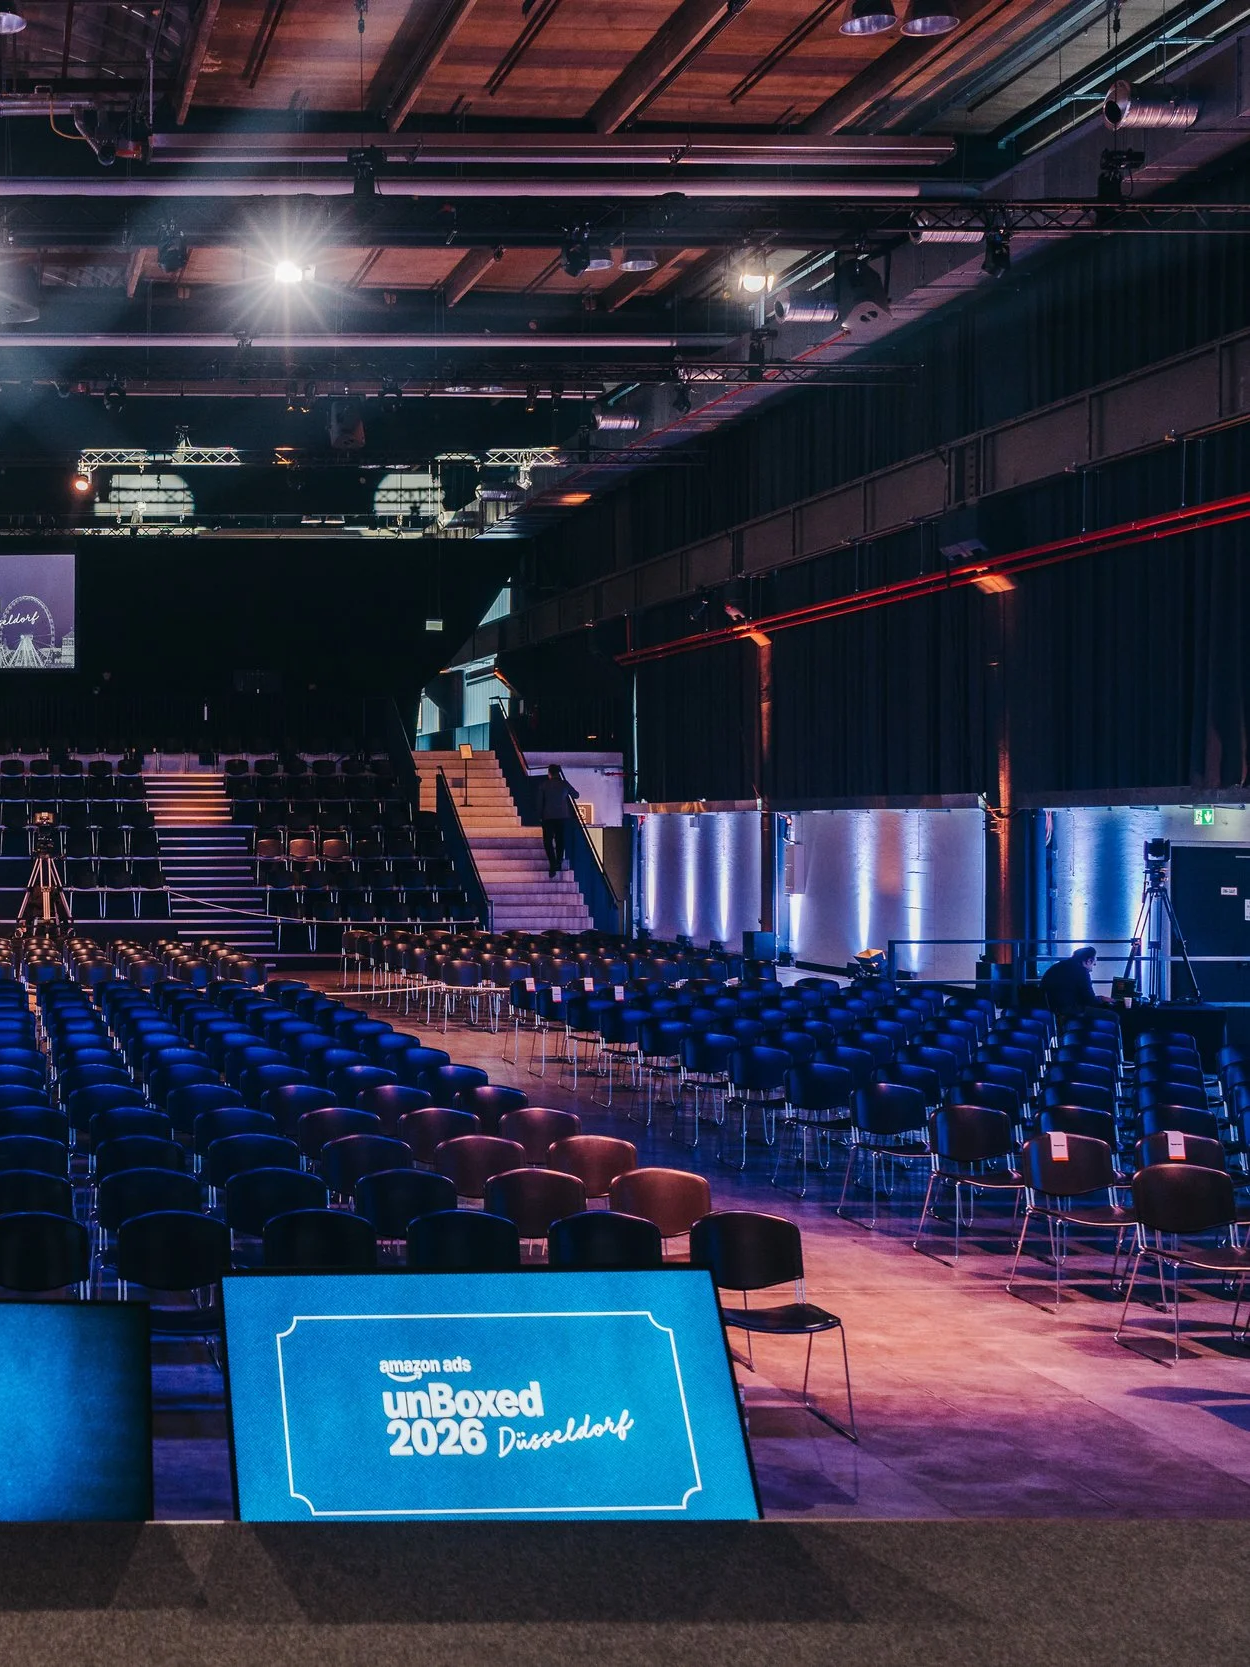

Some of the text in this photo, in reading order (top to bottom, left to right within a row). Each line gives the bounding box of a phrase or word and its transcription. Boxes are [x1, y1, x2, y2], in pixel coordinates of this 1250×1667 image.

[379, 1356, 472, 1374] amazon ads
[382, 1381, 545, 1419] unBoxed
[386, 1409, 635, 1458] 2026 Düsseldorf
